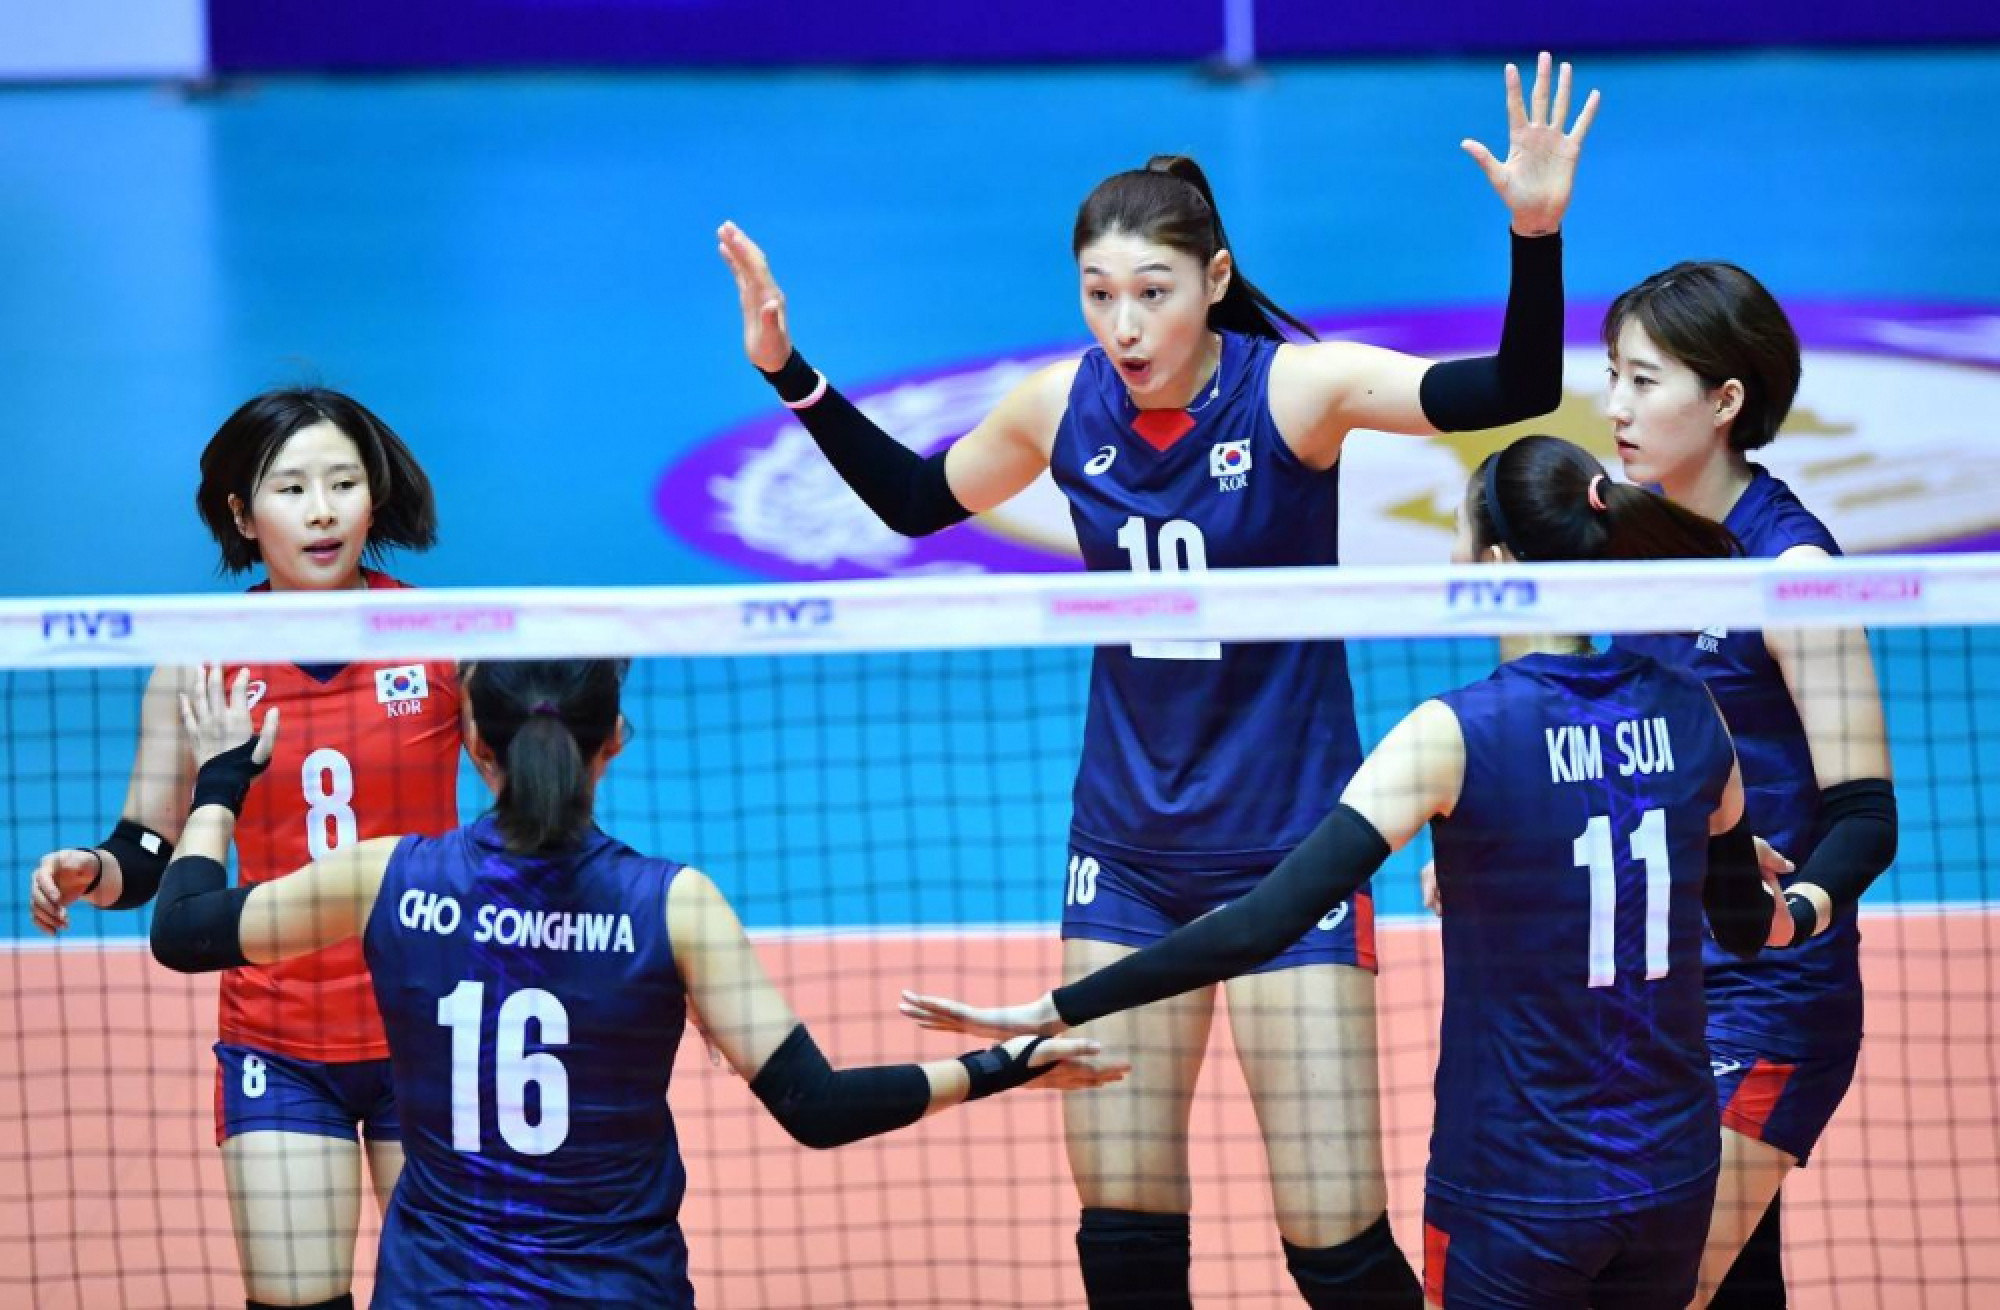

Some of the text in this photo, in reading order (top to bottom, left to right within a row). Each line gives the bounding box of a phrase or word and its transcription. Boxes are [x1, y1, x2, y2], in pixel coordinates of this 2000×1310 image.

[1219, 474, 1248, 492] KOR
[387, 699, 423, 718] KOR
[1545, 717, 1674, 784] KIM SUJI
[302, 748, 358, 862] 8
[1067, 855, 1100, 906] 10
[1572, 807, 1670, 988] 11
[399, 889, 635, 953] CHO SONGHWA
[242, 1055, 267, 1098] 8
[437, 980, 570, 1156] 16
